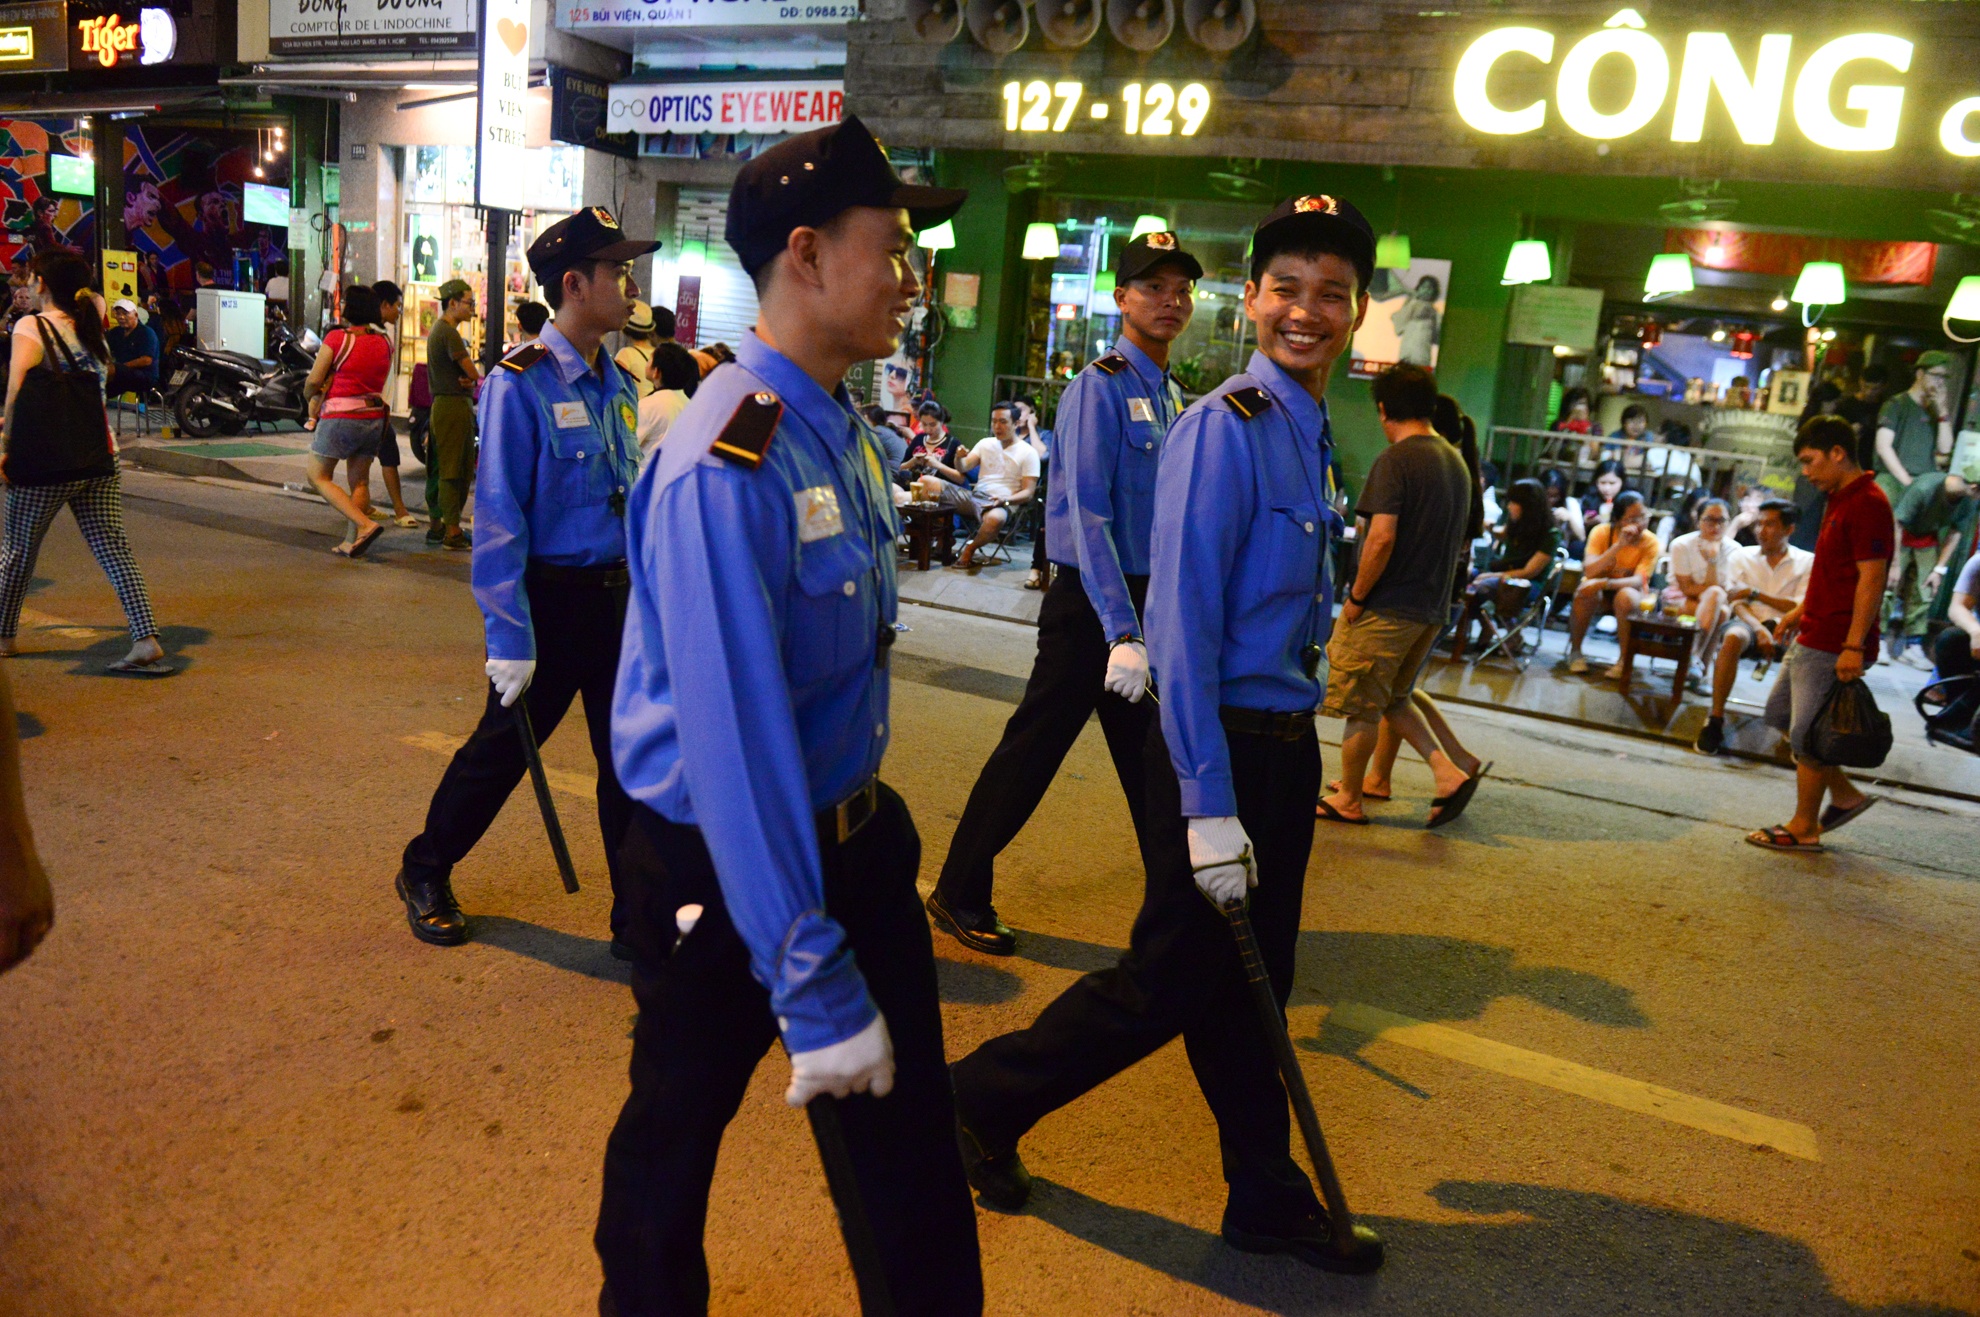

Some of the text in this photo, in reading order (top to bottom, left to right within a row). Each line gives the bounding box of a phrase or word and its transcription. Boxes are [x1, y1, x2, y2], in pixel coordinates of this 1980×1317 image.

[290, 20, 351, 33] COMPTOIR
[355, 20, 370, 31] DE
[569, 8, 590, 22] 125
[806, 6, 863, 18] 0988.23
[79, 13, 140, 67] Tiger
[1453, 8, 1915, 152] CÔNG
[650, 91, 843, 123] OPTICS EYEWEAR
[1003, 80, 1083, 132] 127
[1122, 83, 1211, 136] 129
